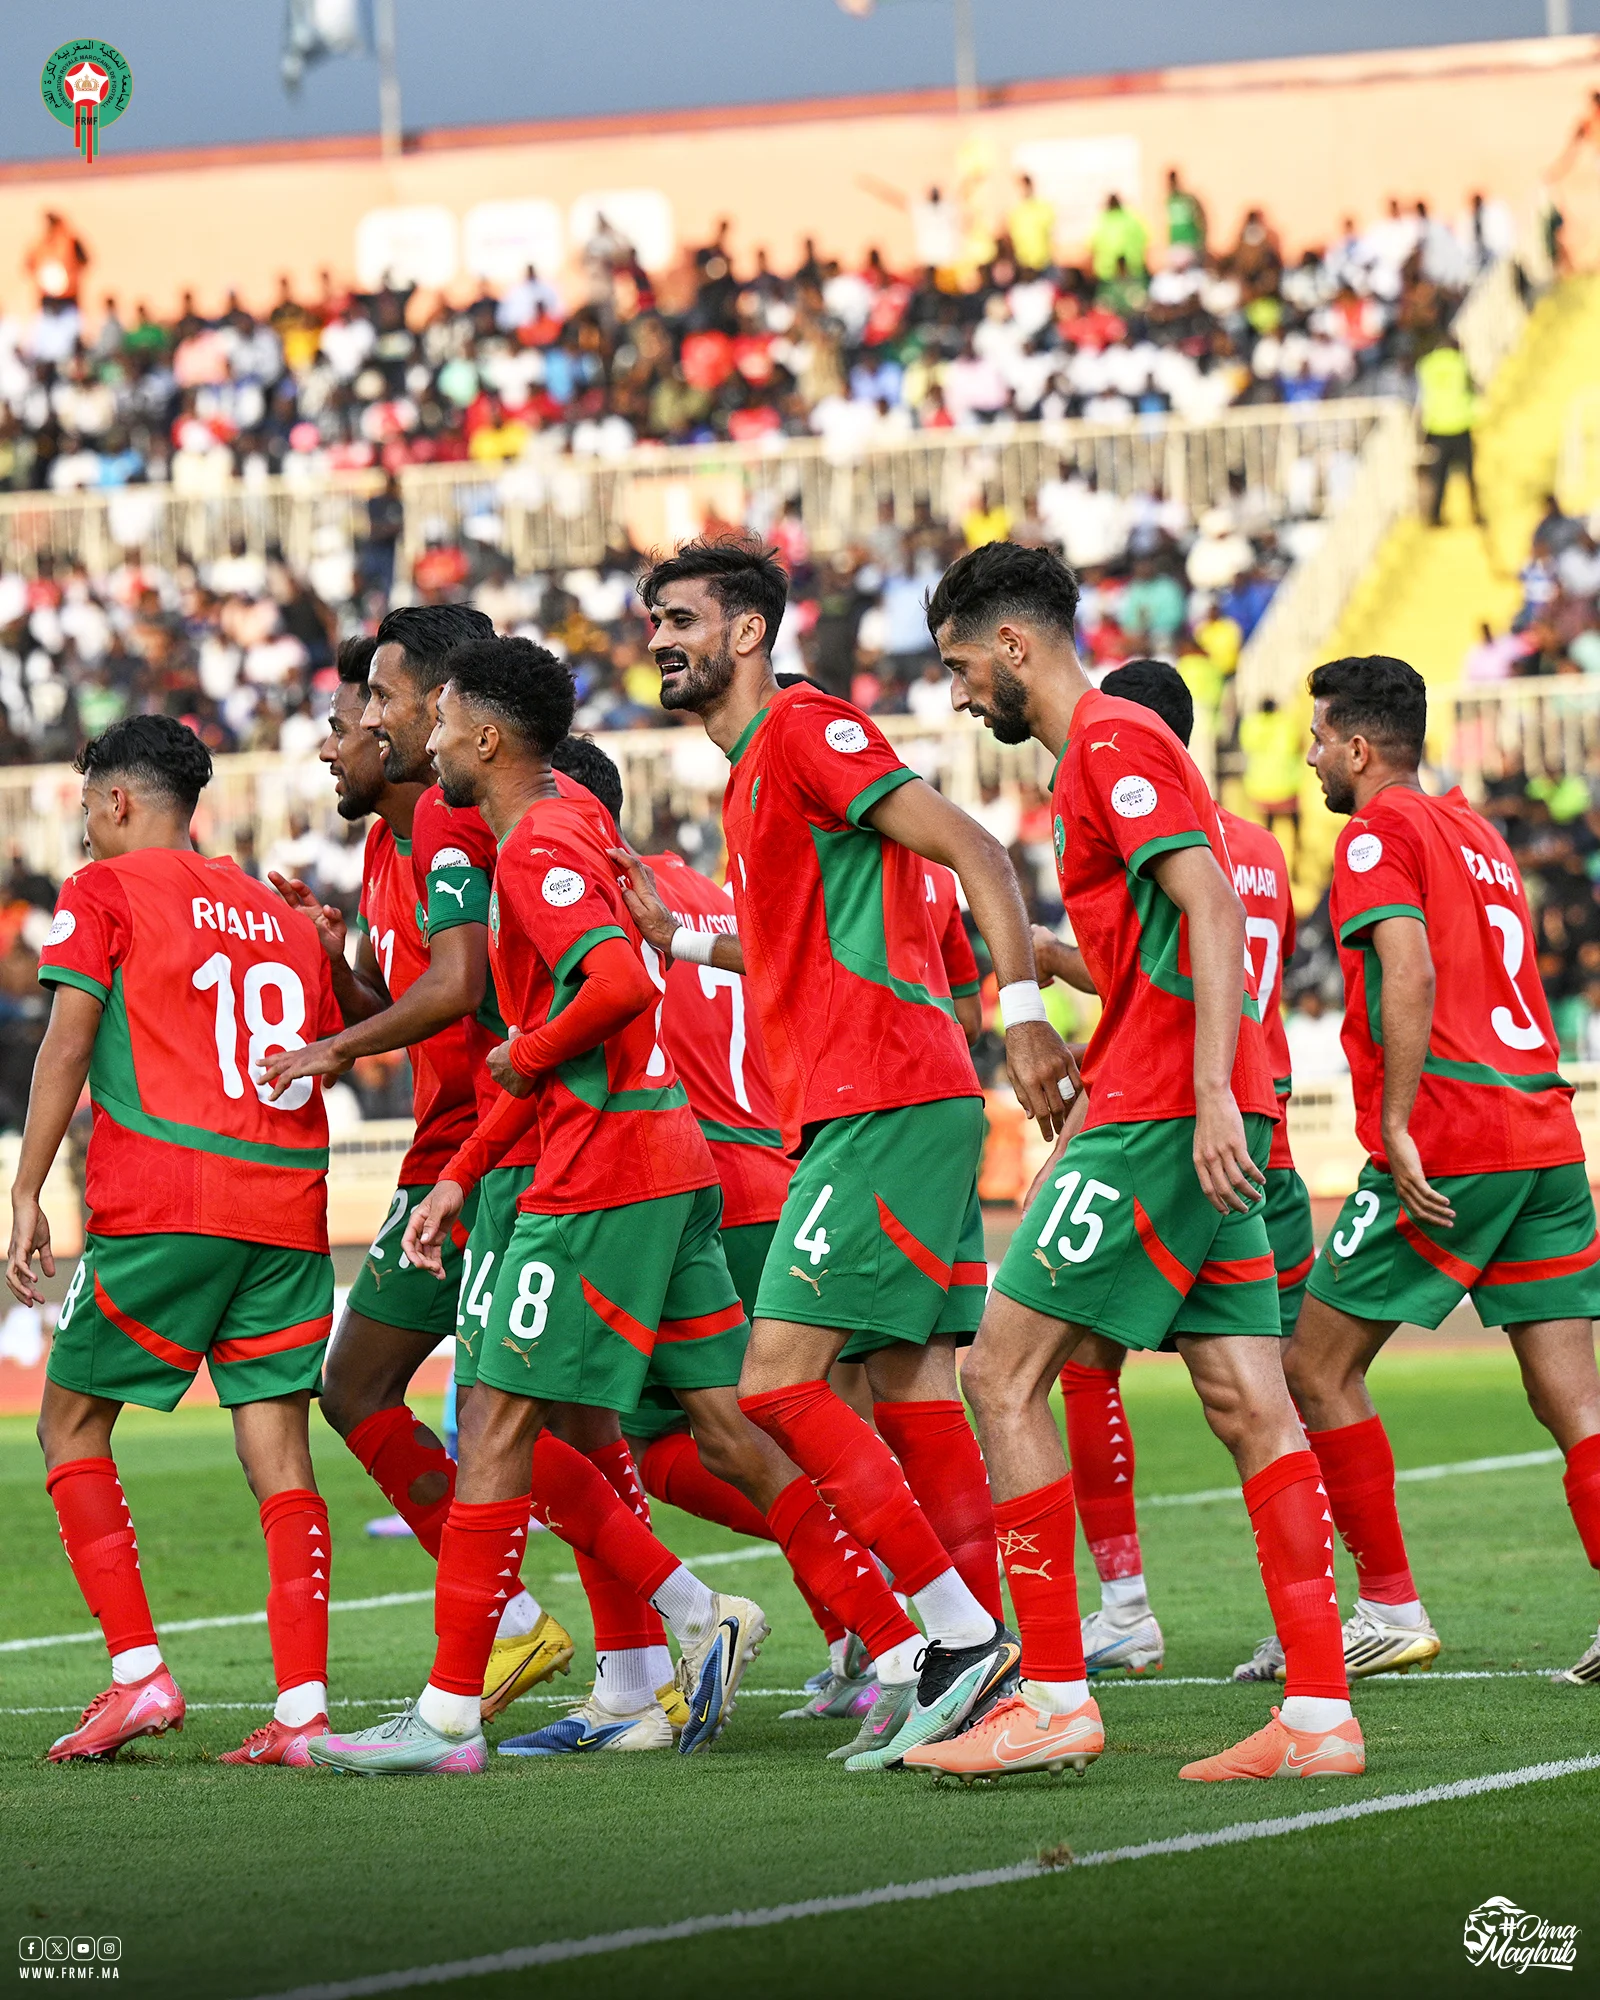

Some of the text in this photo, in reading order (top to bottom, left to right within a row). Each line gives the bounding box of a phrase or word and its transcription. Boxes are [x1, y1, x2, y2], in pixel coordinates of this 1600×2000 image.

[192, 897, 285, 943] RIAHI
[1484, 904, 1546, 1050] 3
[192, 952, 314, 1110] 18
[793, 1184, 833, 1265] 4
[1037, 1171, 1120, 1263] 15
[1332, 1189, 1380, 1258] 3
[456, 1248, 495, 1329] 24
[508, 1261, 555, 1340] 8
